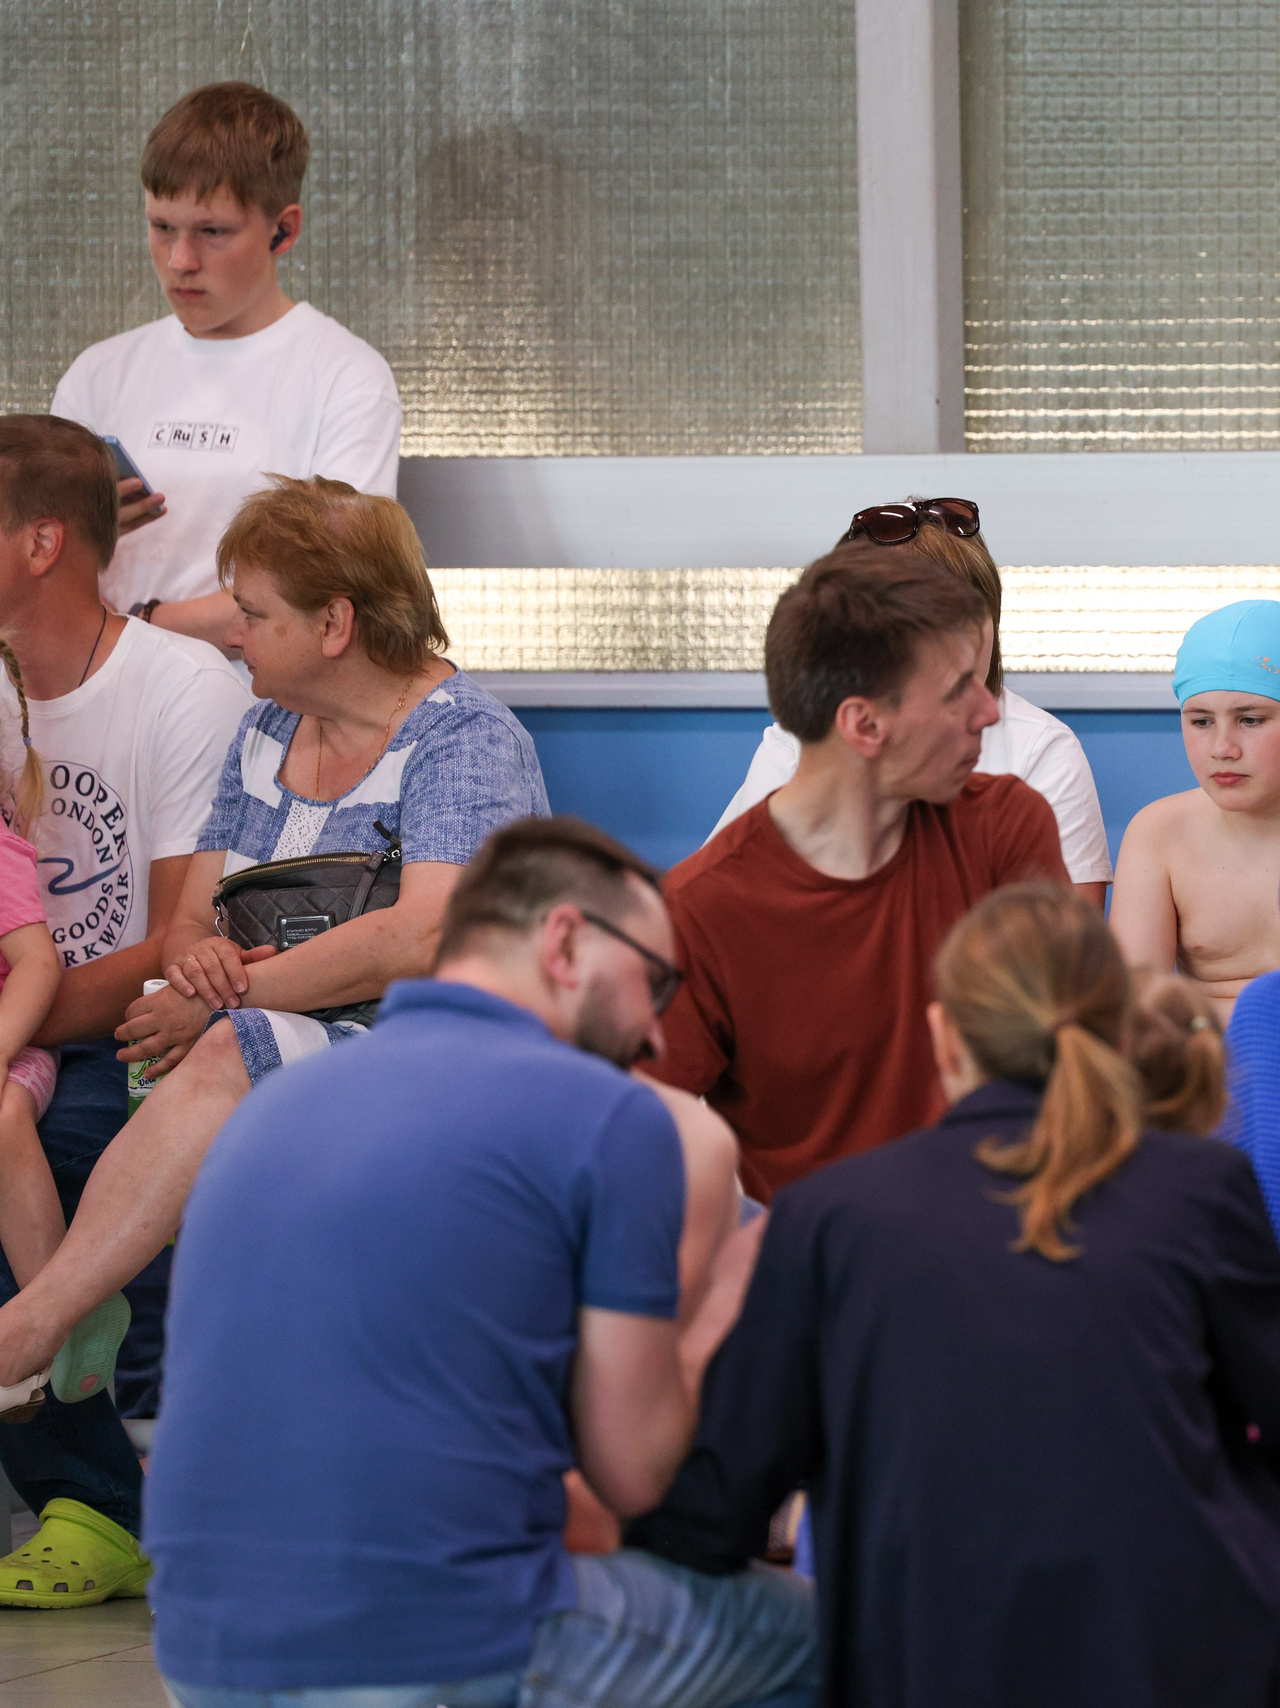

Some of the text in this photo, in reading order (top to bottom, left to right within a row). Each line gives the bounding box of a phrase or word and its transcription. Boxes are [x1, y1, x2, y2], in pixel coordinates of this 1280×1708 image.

[51, 764, 126, 856] OOPER
[51, 798, 114, 864] ONDON
[52, 882, 113, 944] GOODS
[62, 871, 129, 968] RKWEAR
